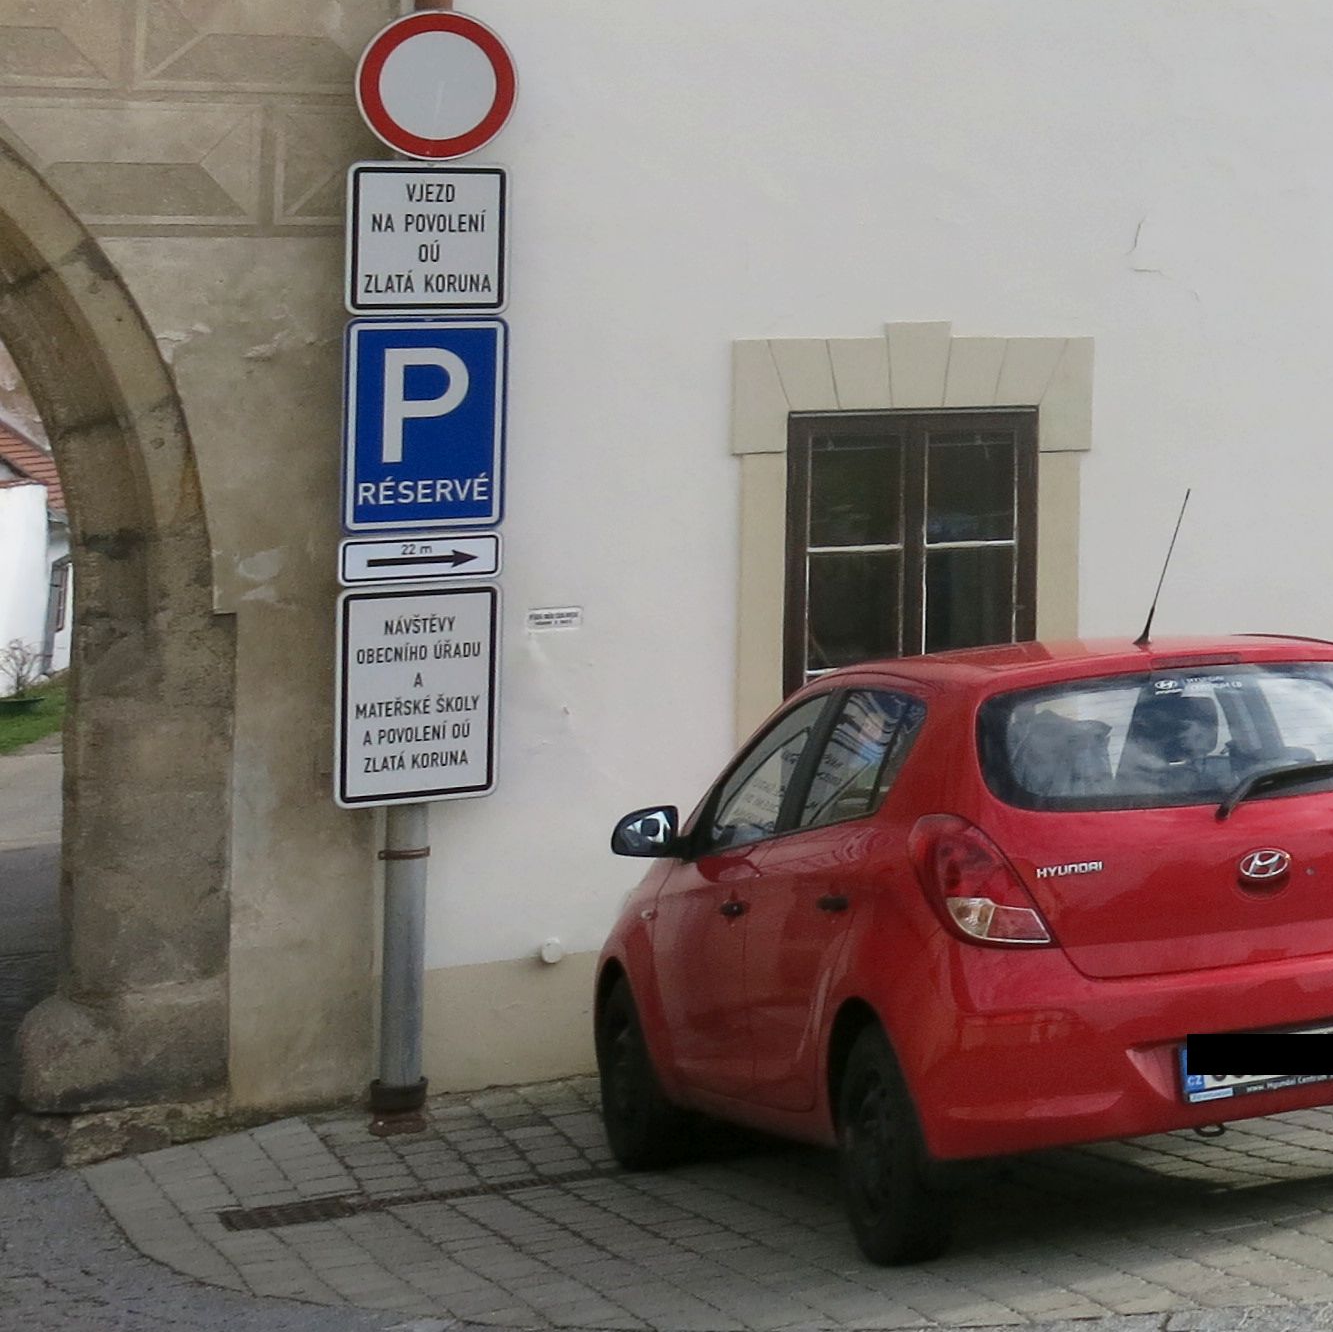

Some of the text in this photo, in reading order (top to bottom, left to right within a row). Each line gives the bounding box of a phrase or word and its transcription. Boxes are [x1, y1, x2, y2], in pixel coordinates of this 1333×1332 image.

[406, 183, 456, 203] VJEZD
[371, 209, 487, 233] NA POVOLENÍ
[418, 239, 440, 263] OÚ
[363, 270, 492, 293] ZLATÁ KORUNA
[382, 347, 469, 463] P
[357, 472, 489, 506] RÉSERVÉ
[401, 544, 432, 556] 22 m
[384, 613, 456, 636] NÁVŠTĚVY
[356, 639, 481, 665] OBECNÍHO ÚŘADU
[413, 672, 423, 688] A
[355, 693, 480, 720] MATEŘSKÉ ŠKOLY
[363, 718, 471, 746] A POVOLENÍ OÚ
[363, 749, 469, 773] ZLATÁ KORUNA
[1036, 860, 1103, 879] HYUNDAI
[1187, 1074, 1203, 1086] CZ
